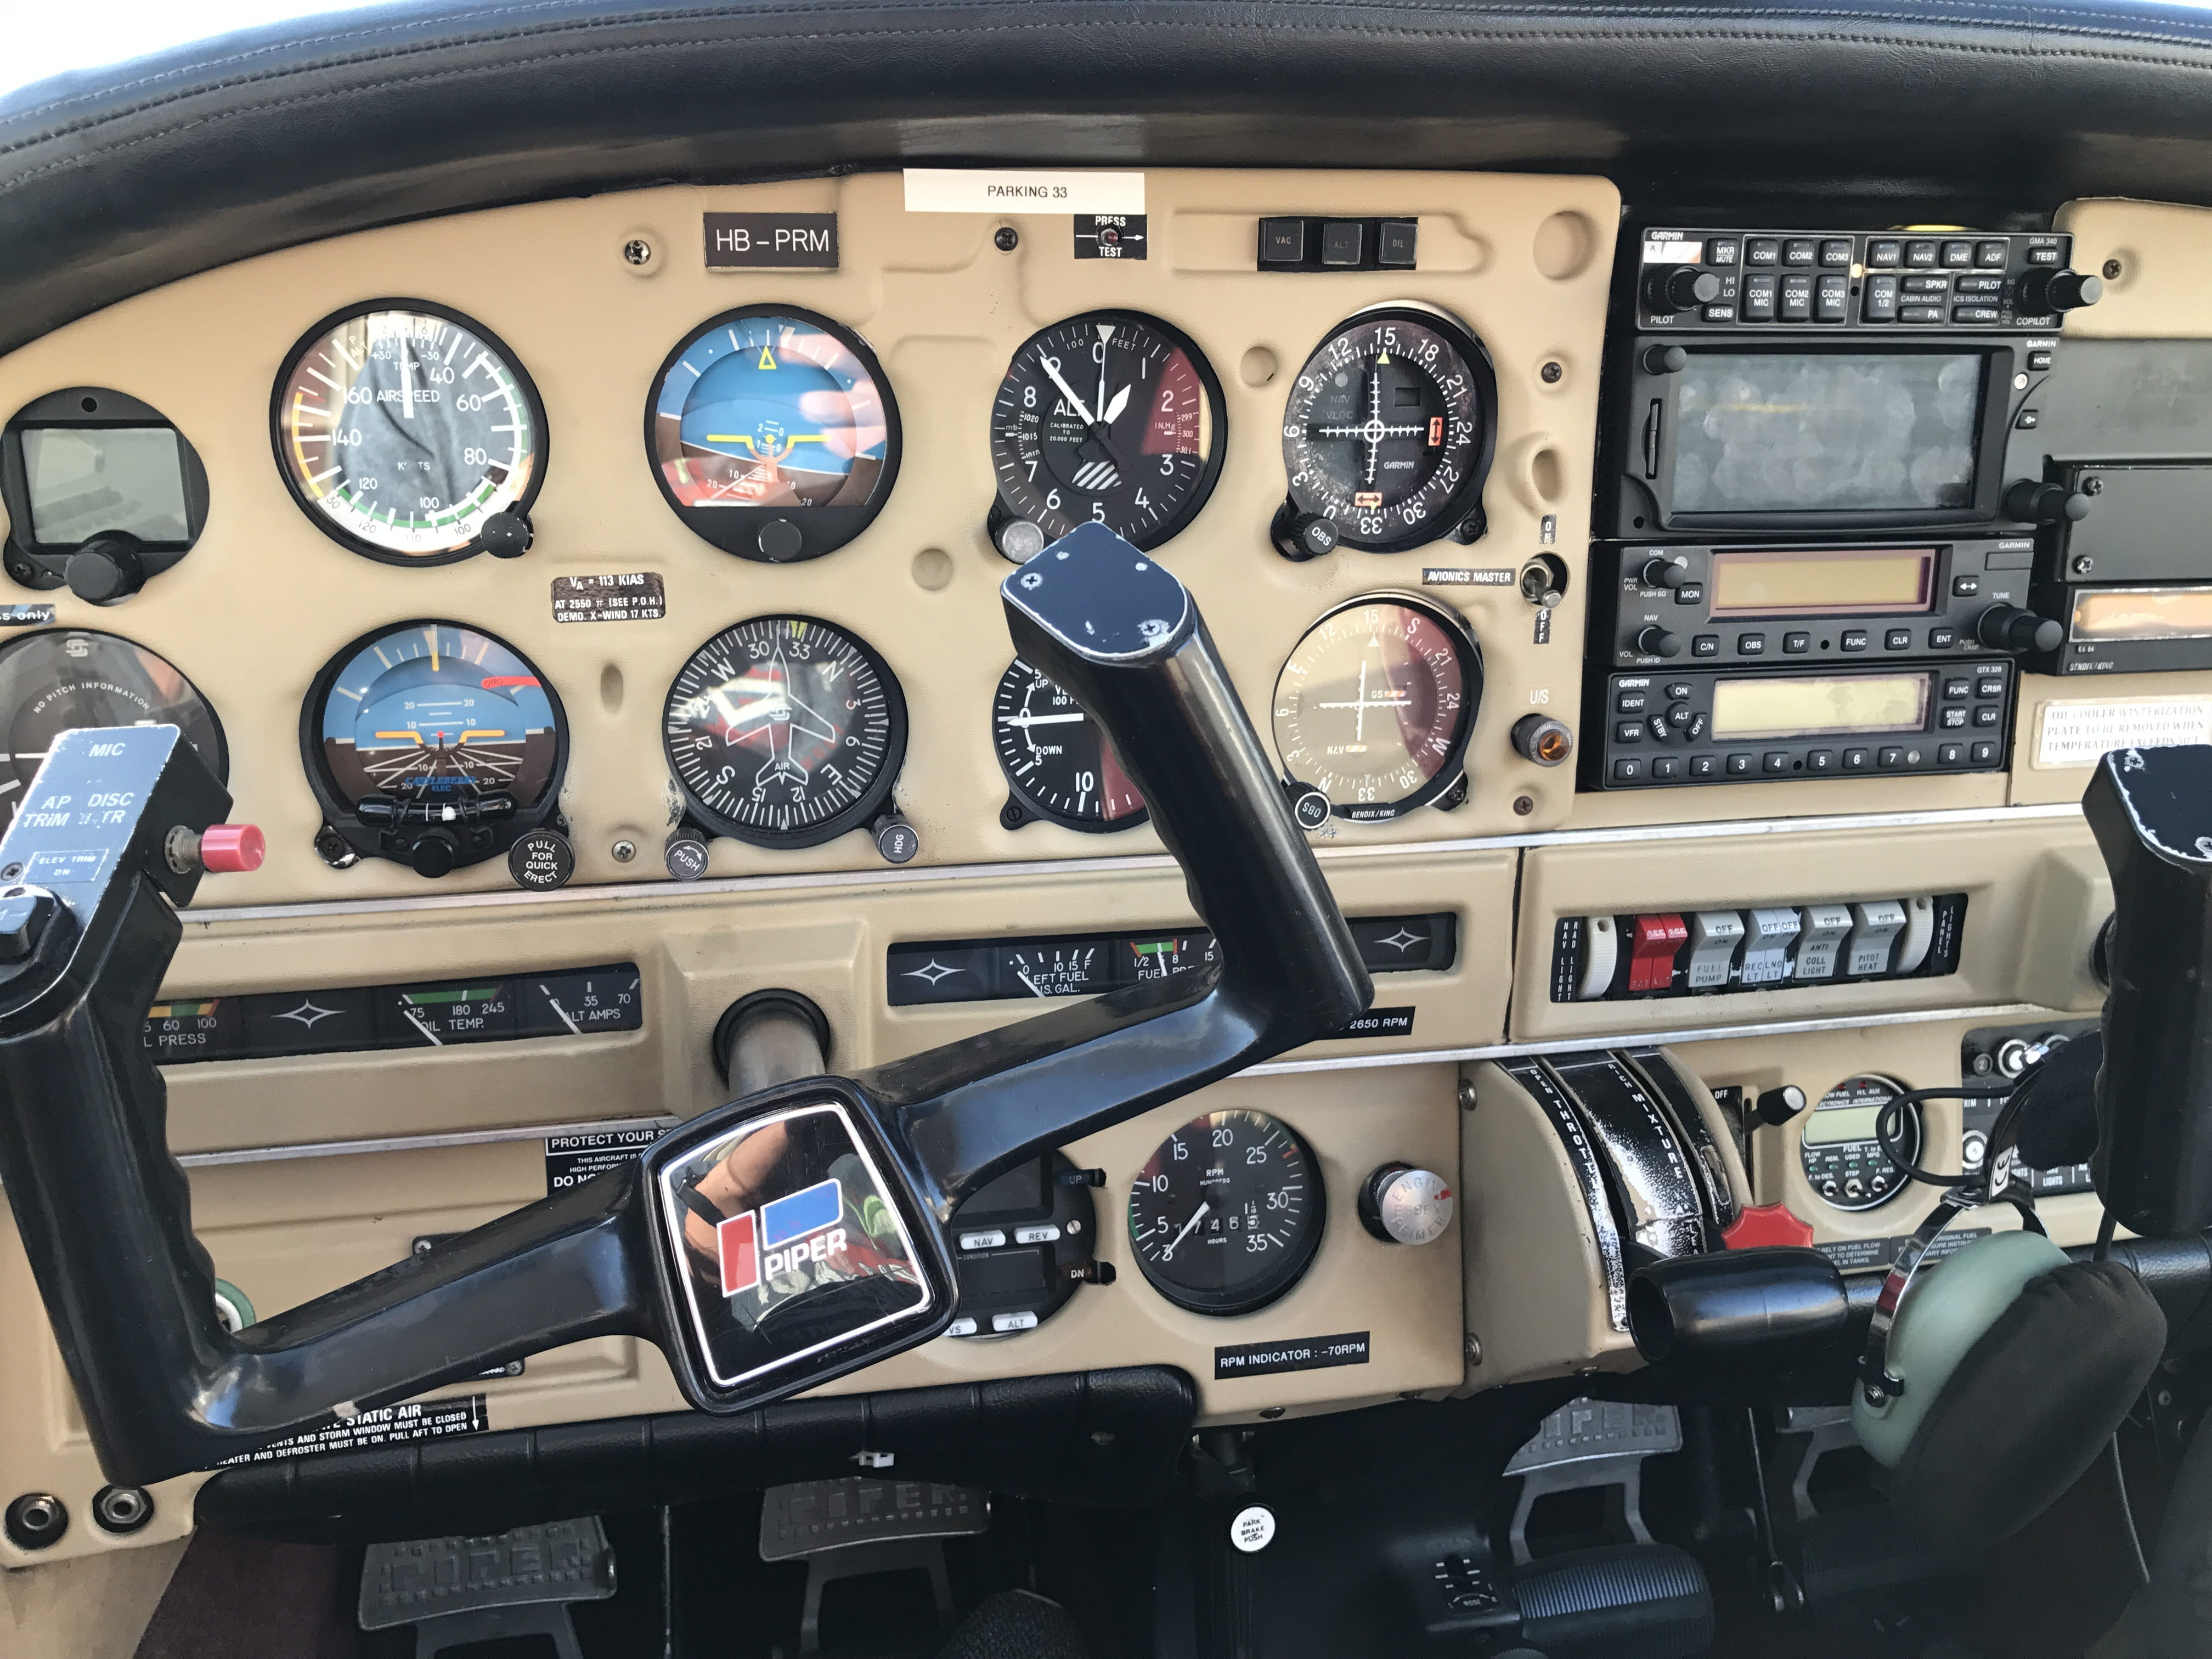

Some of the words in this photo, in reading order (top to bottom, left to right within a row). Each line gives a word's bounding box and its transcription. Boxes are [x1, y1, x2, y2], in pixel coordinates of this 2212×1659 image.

[988, 186, 1047, 199] PARKING
[1052, 188, 1067, 199] 33
[1096, 216, 1126, 227] PRESS
[1651, 232, 1683, 241] GARMIN
[1099, 247, 1122, 257] TEST
[1717, 246, 1735, 255] MKR
[1753, 252, 1776, 260] COM1
[1790, 252, 1813, 260] COM2
[1826, 253, 1848, 261] COM3
[1876, 253, 1897, 262] NAV1
[1913, 253, 1933, 262] NAV2
[1950, 253, 1967, 262] DME
[1985, 253, 2001, 262] ADF
[2036, 252, 2056, 261] TEST
[1925, 281, 1947, 289] SPKR
[1978, 281, 2001, 290] PILOT
[1749, 290, 1773, 298] COM1
[1785, 290, 1809, 298] COM2
[1822, 290, 1844, 298] COM3
[1875, 290, 1893, 298] COM
[1877, 299, 1889, 307] 1/2
[1708, 309, 1733, 317] SENS
[1928, 309, 1938, 318] PA
[1975, 310, 1997, 318] CREW
[1650, 315, 1674, 324] PILOT
[2016, 317, 2050, 325] COPILOT
[1375, 328, 1396, 345] 15
[1067, 339, 1084, 350] 100
[1111, 338, 1136, 351] FEET
[1328, 337, 1352, 360] 12
[332, 429, 362, 446] 140
[1384, 461, 1414, 470] GARMIN
[1311, 527, 1331, 546] OBS
[599, 576, 614, 586] 113
[619, 574, 644, 585] KIAS
[1427, 571, 1470, 582] AVIONICS
[1473, 572, 1510, 582] MASTER
[555, 600, 565, 609] AT
[569, 599, 591, 608] 2550
[609, 597, 628, 607] (SEE
[633, 596, 662, 606] P.O.H.)
[17, 610, 49, 620] only
[558, 612, 586, 622] DEMO.
[630, 610, 638, 618] 17
[642, 609, 661, 618] KTS.
[749, 641, 769, 658] 30
[789, 641, 810, 659] 33
[1035, 680, 1048, 688] UP
[1619, 679, 1650, 687] GARMIN
[1982, 685, 2001, 693] CRSR
[33, 701, 46, 713] NO
[47, 684, 76, 700] PITCH
[81, 682, 150, 710] INFORMATION
[1530, 690, 1549, 704] U/S
[89, 743, 126, 757] MIC
[1036, 746, 1062, 755] DOWN
[1076, 771, 1093, 792] 10
[41, 796, 71, 809] AP
[88, 792, 134, 807] DISC
[1351, 809, 1395, 819] BENDIX/KING
[527, 841, 555, 853] PULL
[894, 834, 904, 853] HDG
[532, 852, 552, 860] FOR
[674, 850, 700, 871] PUSH
[526, 861, 558, 870] QUICK
[524, 871, 557, 883] ERECT
[1716, 925, 1733, 933] OFF
[1859, 954, 1879, 962] PITOT
[1059, 971, 1088, 981] FUEL
[1695, 974, 1722, 983] PUMP
[1055, 984, 1080, 993] GAL.
[589, 1008, 620, 1020] AMPS
[1350, 1019, 1378, 1029] 2650
[1383, 1018, 1408, 1027] RPM
[159, 1033, 206, 1046] PRESS
[1715, 1090, 1728, 1099] OFF
[551, 1134, 613, 1148] PROTECT
[617, 1131, 654, 1143] YOUR
[1212, 1128, 1233, 1147] 20
[1633, 1094, 1683, 1178] MIXTURE
[594, 1154, 629, 1163] AIRCRAFT
[1246, 1147, 1267, 1164] 25
[1266, 1192, 1288, 1210] 30
[1029, 1232, 1048, 1241] REV
[974, 1238, 993, 1246] NAV
[764, 1228, 847, 1281] PIPER
[1007, 1319, 1024, 1329] ALT
[1221, 1357, 1244, 1367] RPM
[1249, 1349, 1310, 1364] INDICATOR
[398, 1404, 421, 1419] AIR
[297, 1434, 316, 1443] AND
[319, 1429, 350, 1441] STORM
[353, 1423, 391, 1435] WINDOW
[394, 1420, 418, 1430] MUST
[436, 1412, 466, 1423] CLOSED
[254, 1451, 273, 1460] AND
[276, 1444, 325, 1457] DEFROSTER
[329, 1438, 353, 1449] MUST
[358, 1437, 368, 1446] BE
[390, 1431, 409, 1441] PULL
[413, 1429, 427, 1438] AFT
[445, 1423, 467, 1433] OPEN
[1243, 1519, 1261, 1527] PARK
[1242, 1526, 1265, 1536] BRAKE
